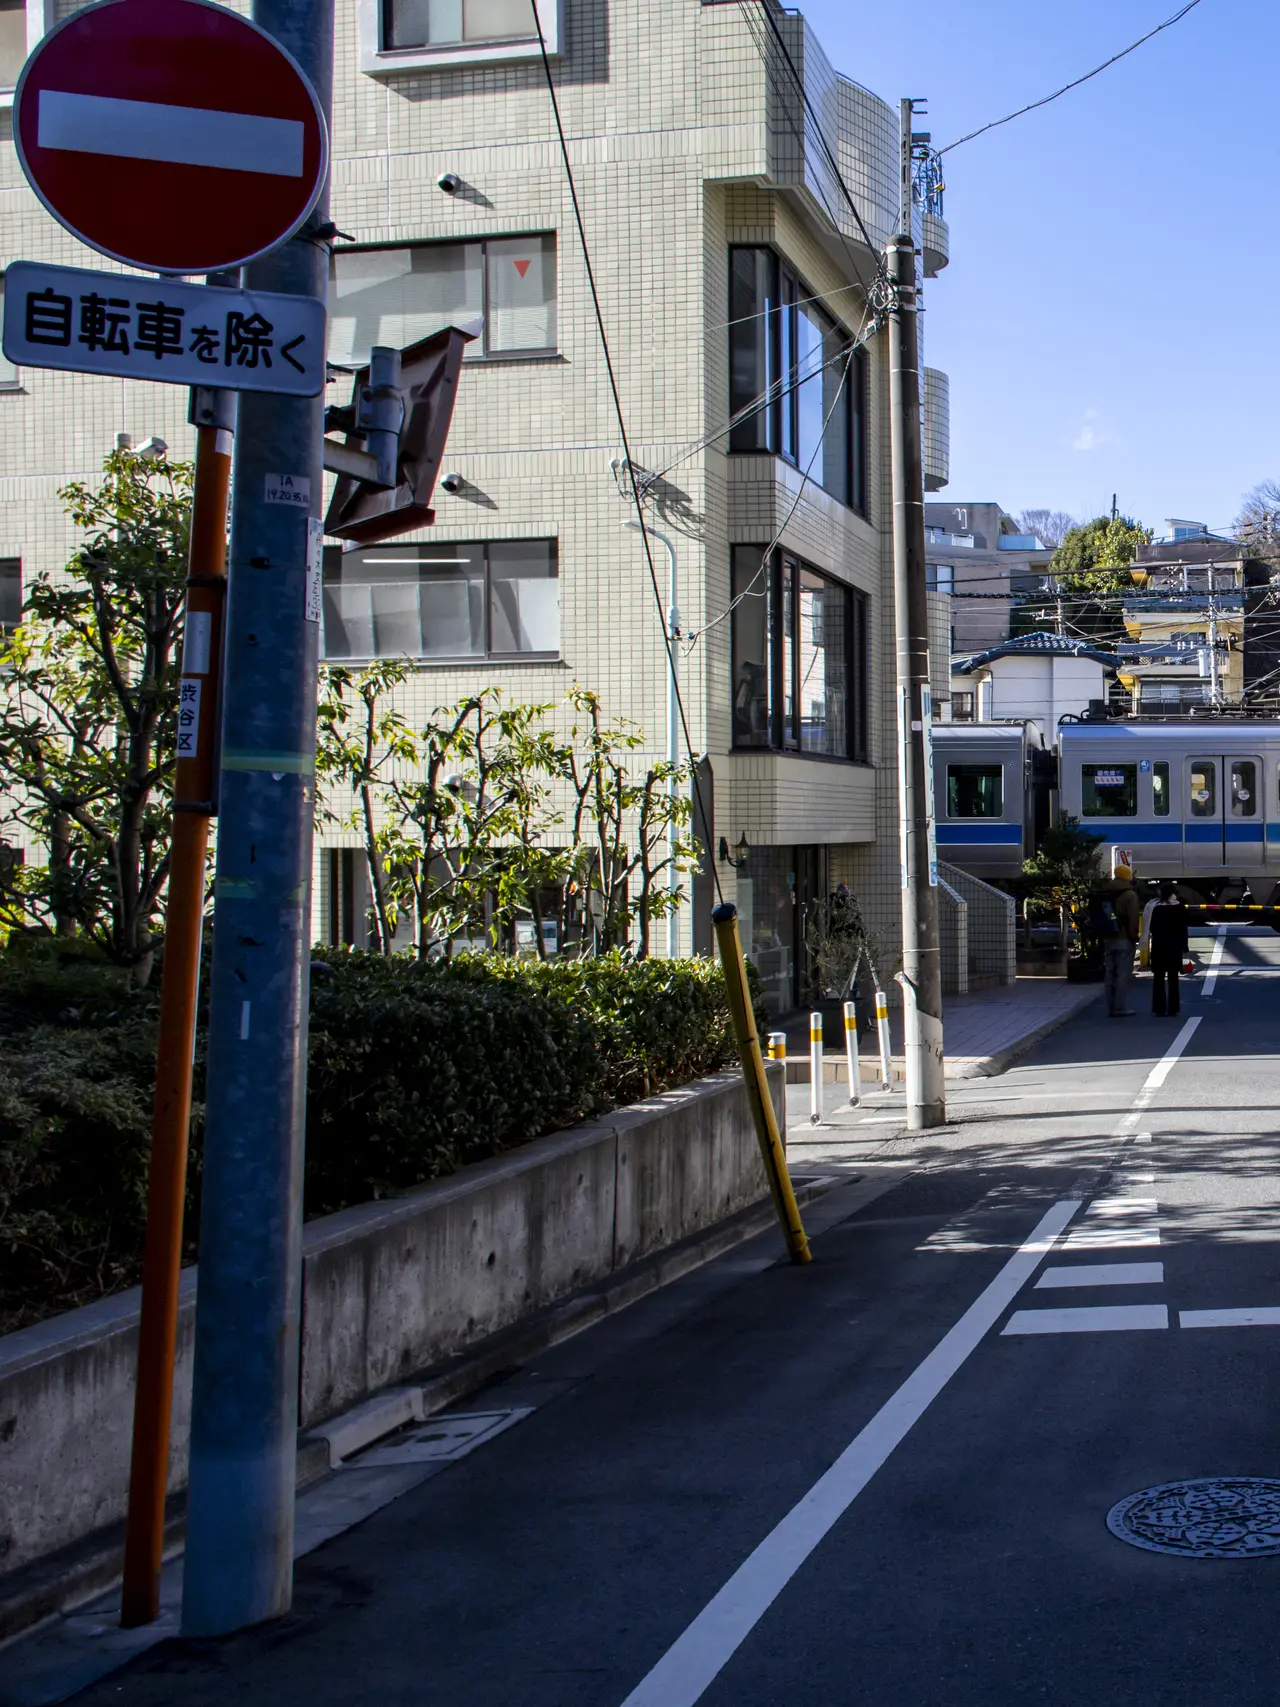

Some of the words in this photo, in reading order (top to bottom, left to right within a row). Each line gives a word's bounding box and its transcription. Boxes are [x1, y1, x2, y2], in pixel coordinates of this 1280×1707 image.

[25, 286, 305, 374] 自転車を除く
[178, 683, 198, 750] 渋谷区
